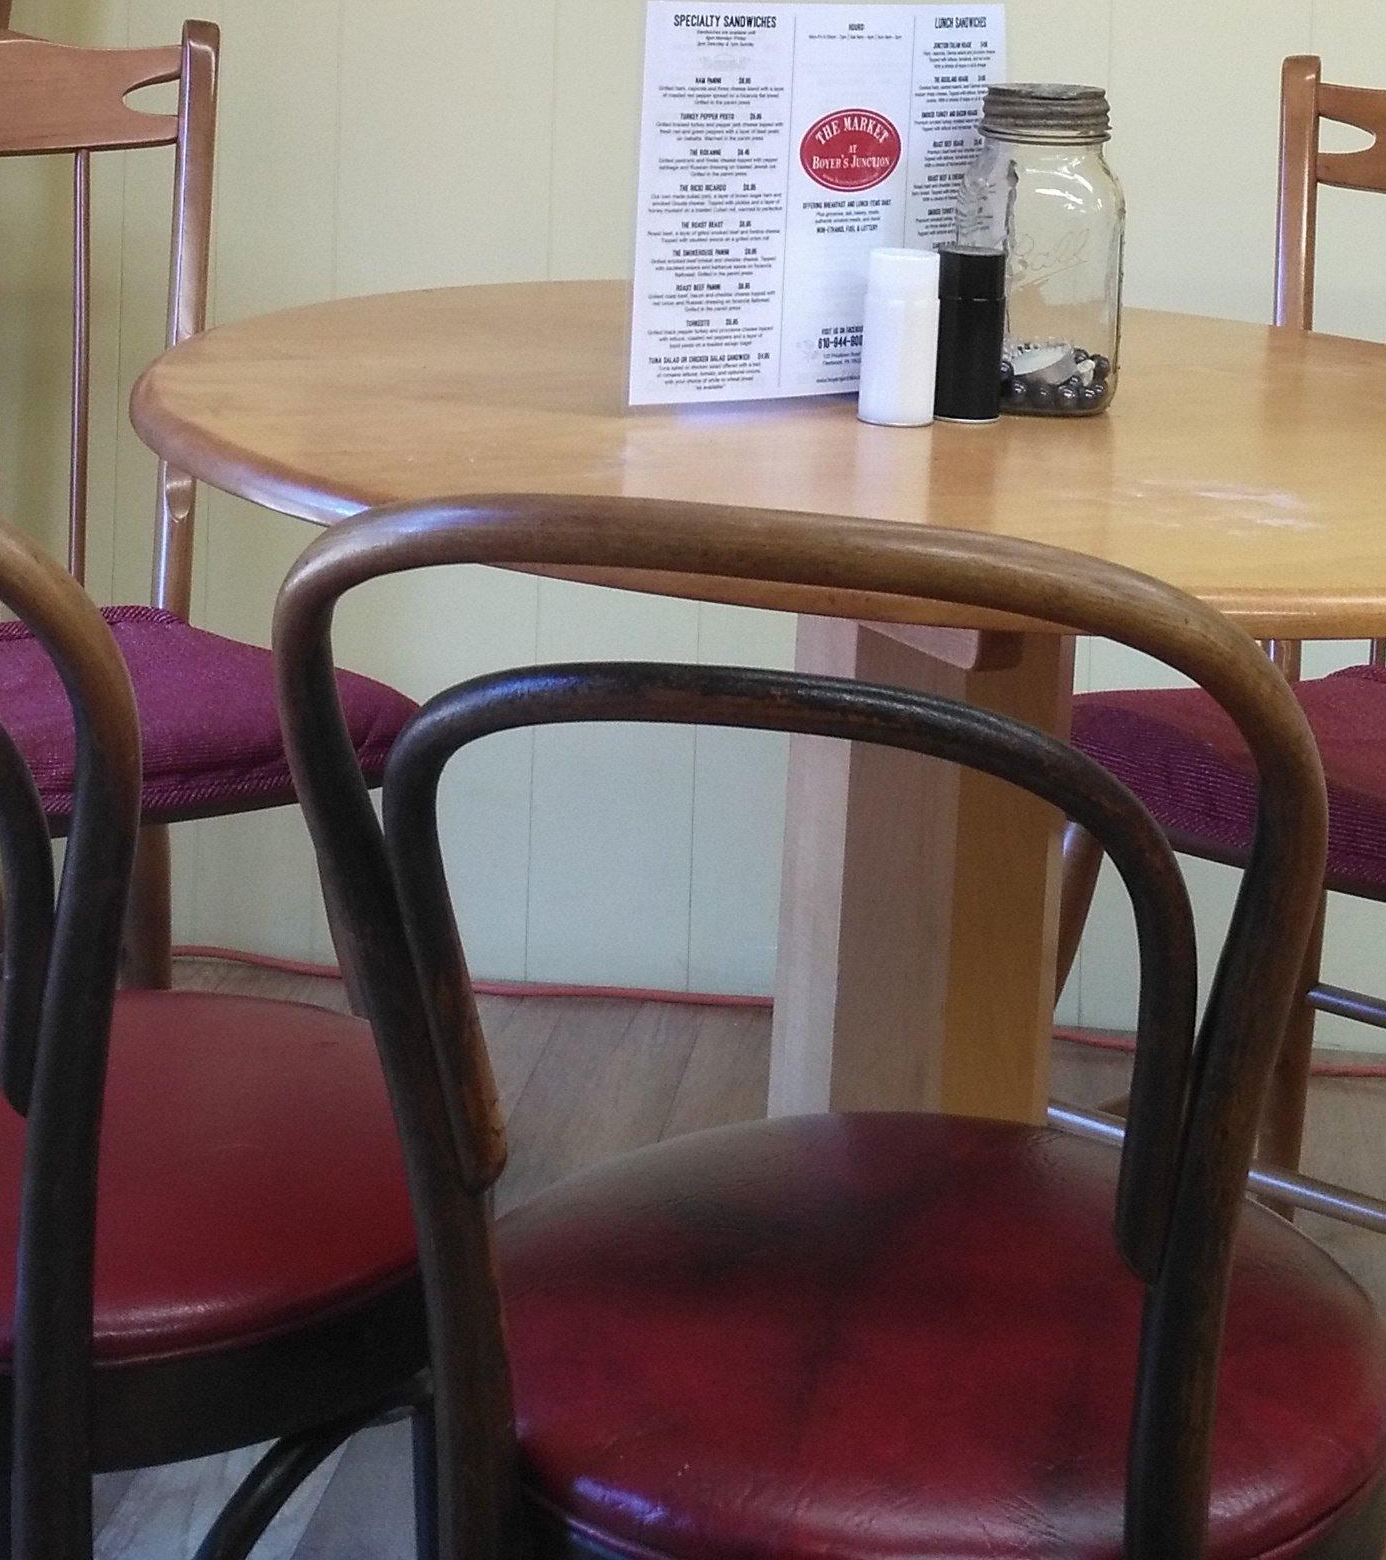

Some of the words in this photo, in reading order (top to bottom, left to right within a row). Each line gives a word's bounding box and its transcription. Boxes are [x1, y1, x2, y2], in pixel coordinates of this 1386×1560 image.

[673, 14, 721, 28] SPECIALTY
[723, 15, 777, 29] SANDWICHES
[934, 16, 954, 29] LUNCH
[955, 16, 987, 29] SANDWICHES
[815, 120, 841, 145] THE
[843, 116, 890, 143] MARKET
[848, 144, 858, 154] AT
[812, 154, 850, 170] BOYER'S
[851, 154, 890, 168] JUNCTION
